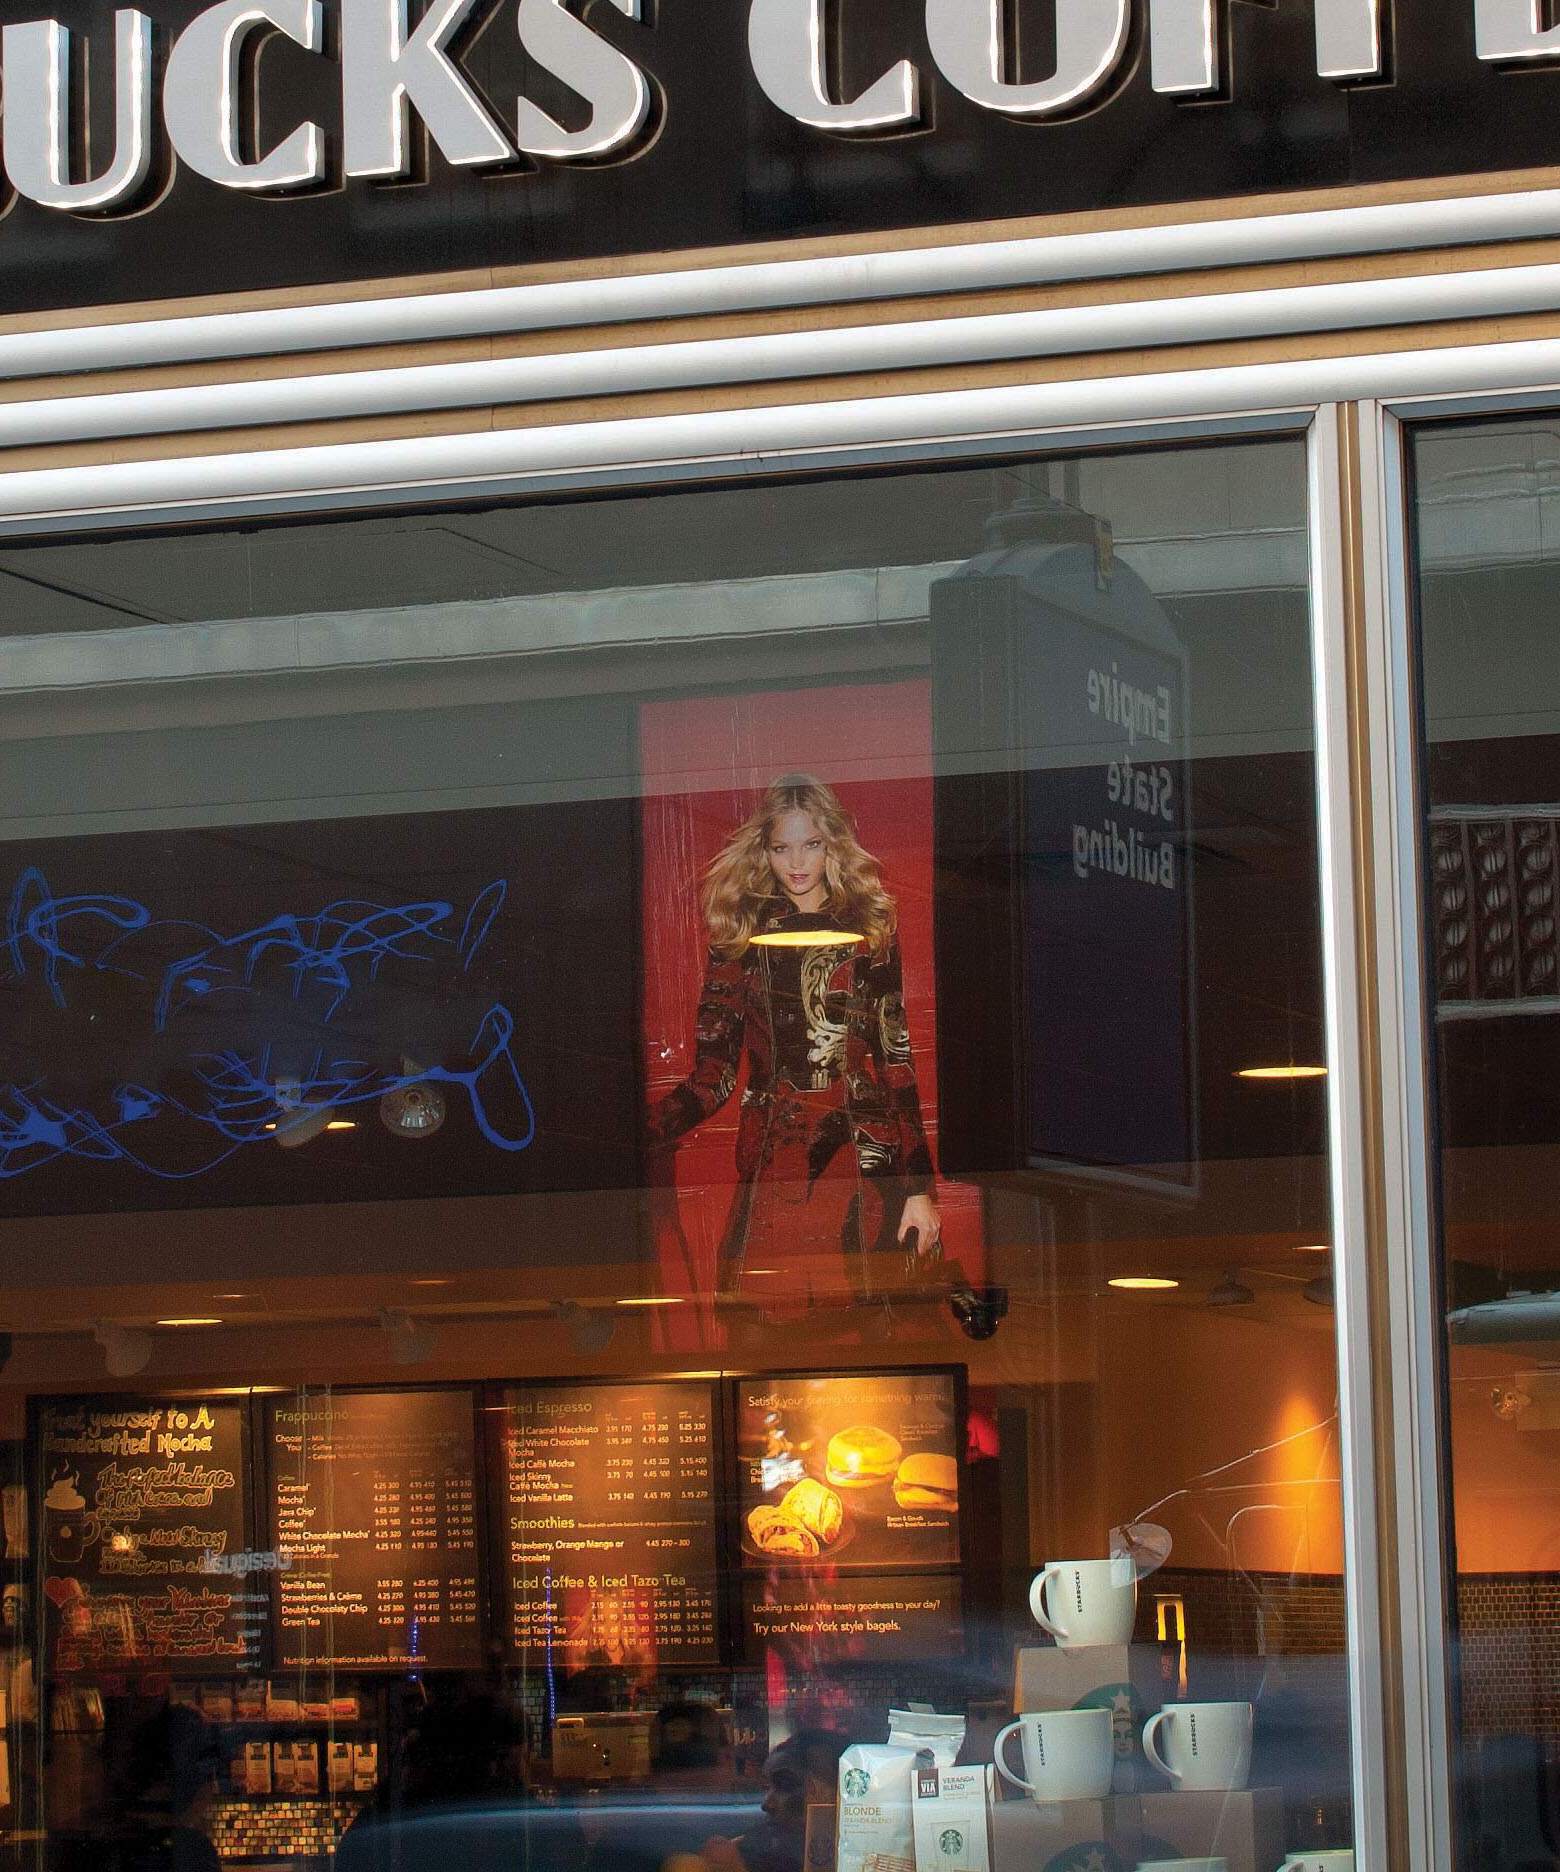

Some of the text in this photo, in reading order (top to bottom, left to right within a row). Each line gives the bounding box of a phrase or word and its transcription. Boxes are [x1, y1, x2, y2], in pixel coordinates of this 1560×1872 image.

[748, 1395, 779, 1409] Satisfy
[781, 1397, 803, 1409] your
[537, 1402, 592, 1418] Espresso
[191, 1406, 215, 1429] A
[275, 1409, 349, 1424] Frappuccino
[526, 1426, 558, 1434] Caramel
[157, 1432, 213, 1458] Mocha
[526, 1439, 548, 1447] White
[550, 1438, 589, 1447] Chocolate
[509, 1449, 535, 1457] Mocha
[548, 1459, 575, 1468] Mocha
[509, 1472, 552, 1481] Iced Skinny
[277, 1483, 309, 1492] Caramel
[532, 1481, 559, 1489] Mocha
[278, 1496, 304, 1505] Mocha
[510, 1494, 573, 1503] Iced Vanilla Latte
[278, 1507, 315, 1517] Java Chip
[278, 1520, 304, 1528] Coffee
[510, 1516, 575, 1529] Smoothies
[279, 1530, 369, 1540] White Chocolate Mocha
[279, 1544, 325, 1553] Mocha Light
[511, 1540, 624, 1551] Strawberry, Orange Mango or
[511, 1554, 551, 1562] Chocolate
[280, 1581, 325, 1589] Vanilla Bean
[512, 1574, 686, 1589] Iced Coffee & Iced Tazo Tea
[280, 1593, 328, 1602] Strawberries
[281, 1604, 368, 1615] Double Chocolaty Chip
[514, 1601, 557, 1610] Iced Coffee
[753, 1603, 782, 1613] Looking
[793, 1603, 808, 1611] add
[816, 1602, 832, 1611] little
[833, 1601, 855, 1613] toasty
[857, 1601, 894, 1612] goodness
[895, 1601, 904, 1609] to
[905, 1602, 922, 1612] your
[924, 1599, 940, 1611] day?
[281, 1617, 320, 1626] Green Tea
[514, 1614, 558, 1622] Iced Coffee
[514, 1626, 531, 1635] Iced
[553, 1626, 566, 1634] Tea
[753, 1619, 901, 1637] Try our New York style bagels.
[515, 1638, 588, 1647] Iced Tea Lemonade
[316, 1656, 355, 1664] information
[401, 1655, 428, 1664] request.
[920, 1783, 936, 1794] VIA
[844, 1807, 881, 1816] BLONDE
